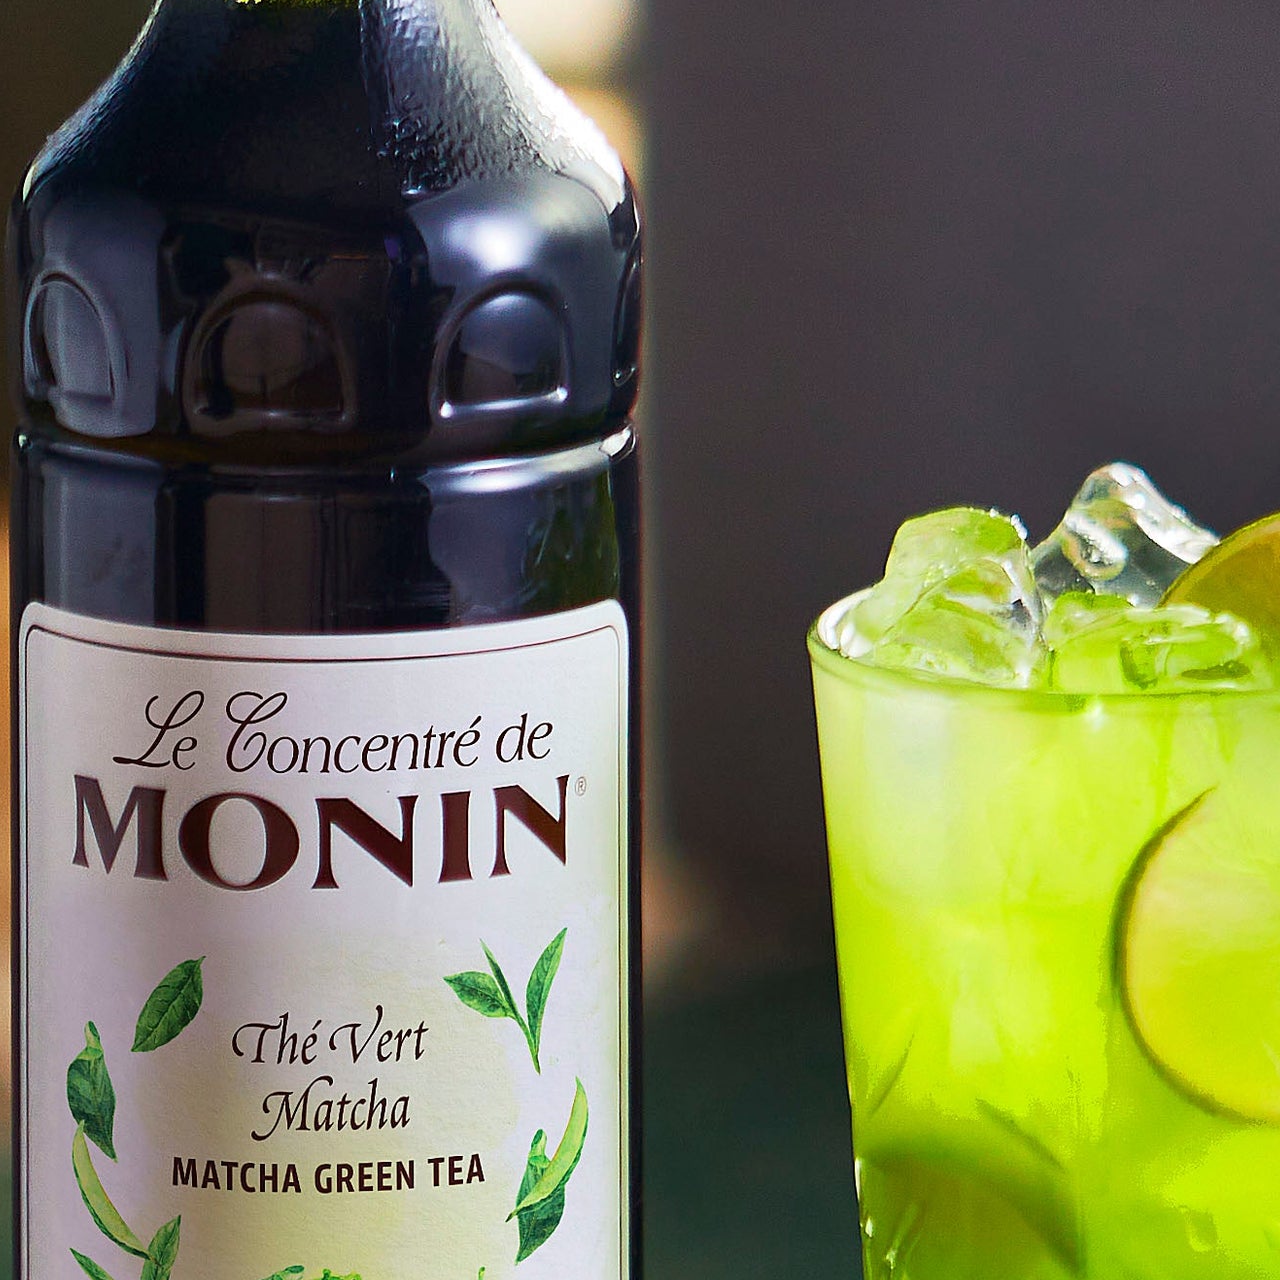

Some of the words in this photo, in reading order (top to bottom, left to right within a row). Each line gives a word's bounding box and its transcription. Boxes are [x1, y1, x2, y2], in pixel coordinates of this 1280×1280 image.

[112, 690, 206, 771] Le
[225, 691, 483, 774] Concentré
[495, 712, 554, 764] de
[71, 773, 571, 892] MONIN
[231, 1012, 323, 1066] Thé
[328, 1004, 431, 1064] Vert
[250, 1075, 412, 1142] Matcha
[172, 1156, 302, 1194] MATCHA
[314, 1159, 416, 1194] GREEN
[427, 1153, 486, 1188] TEA
